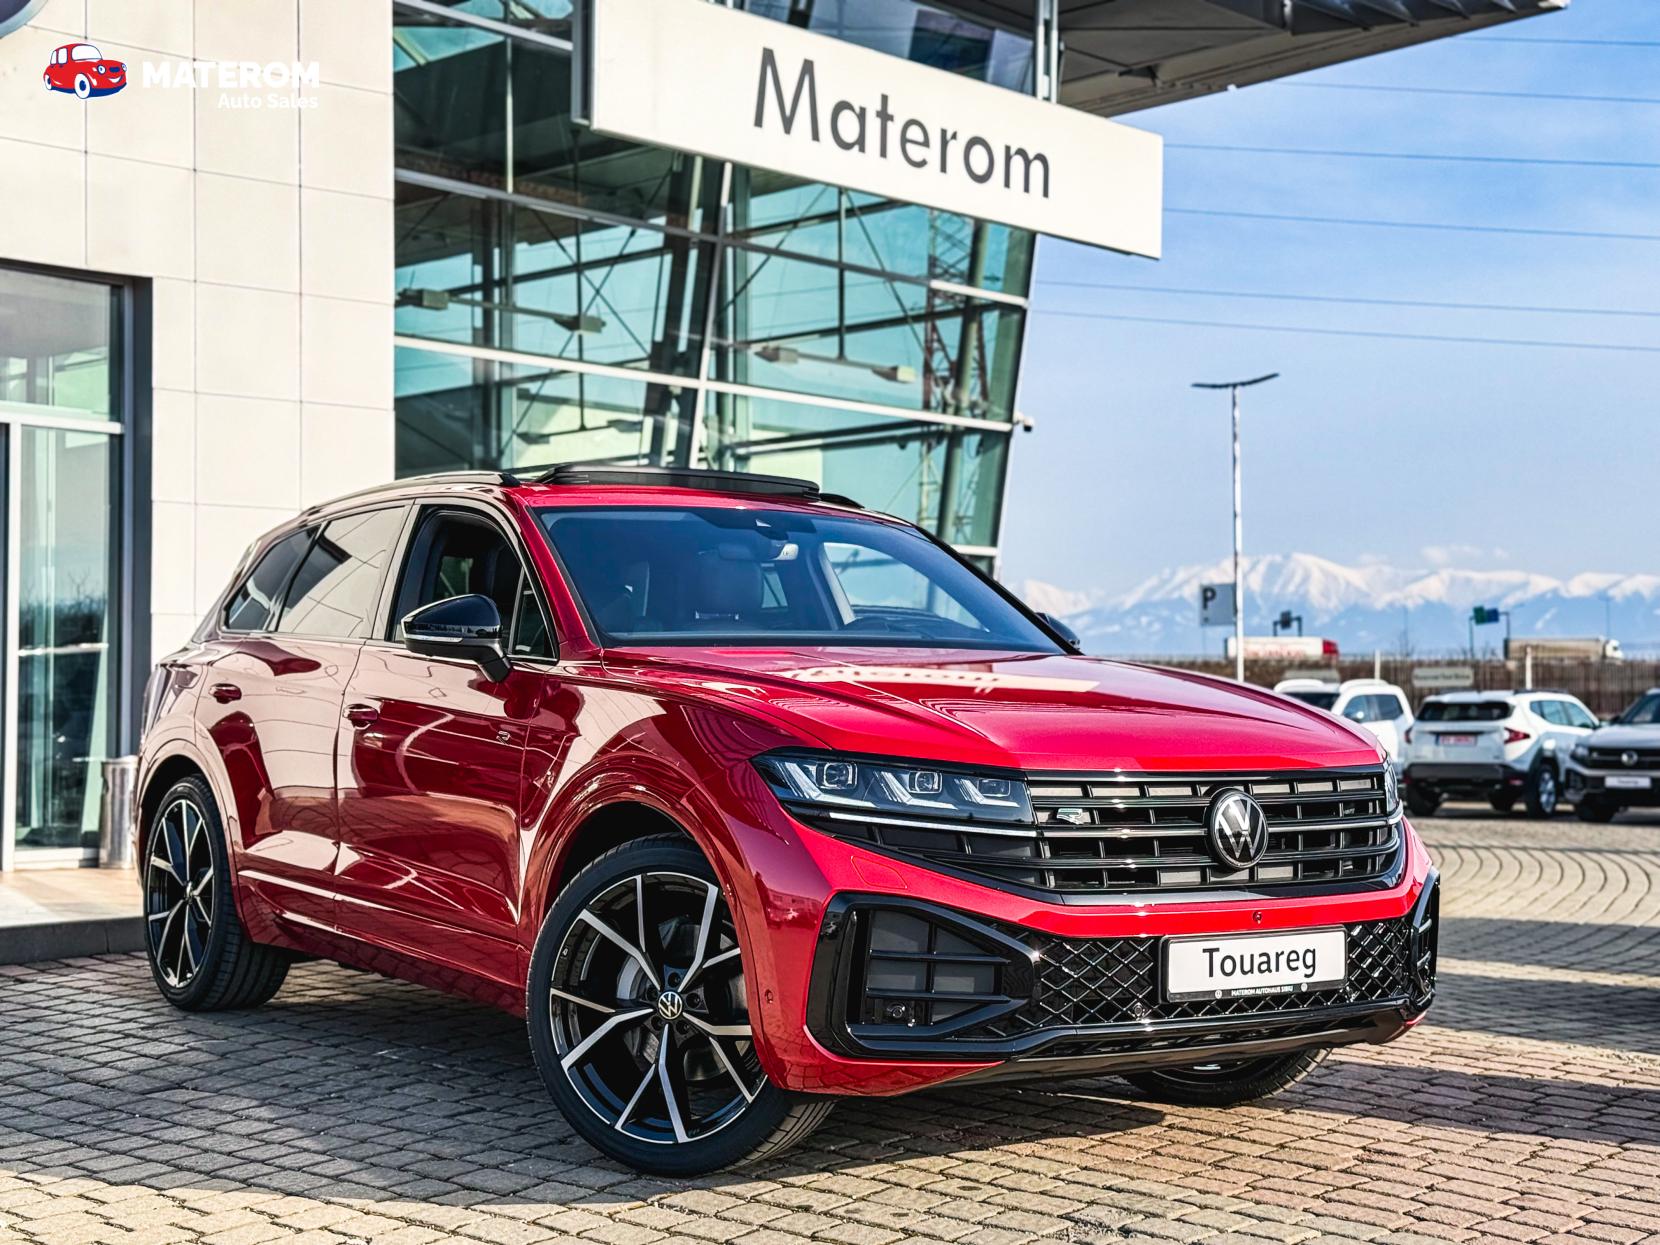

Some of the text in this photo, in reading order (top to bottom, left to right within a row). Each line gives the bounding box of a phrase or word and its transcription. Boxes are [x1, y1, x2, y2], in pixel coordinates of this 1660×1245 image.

[754, 47, 1050, 199] Materom
[1202, 586, 1217, 611] P
[1202, 947, 1316, 979] Touareg
[1231, 988, 1256, 997] MATEROM
[1256, 986, 1281, 995] AUTOHAUS
